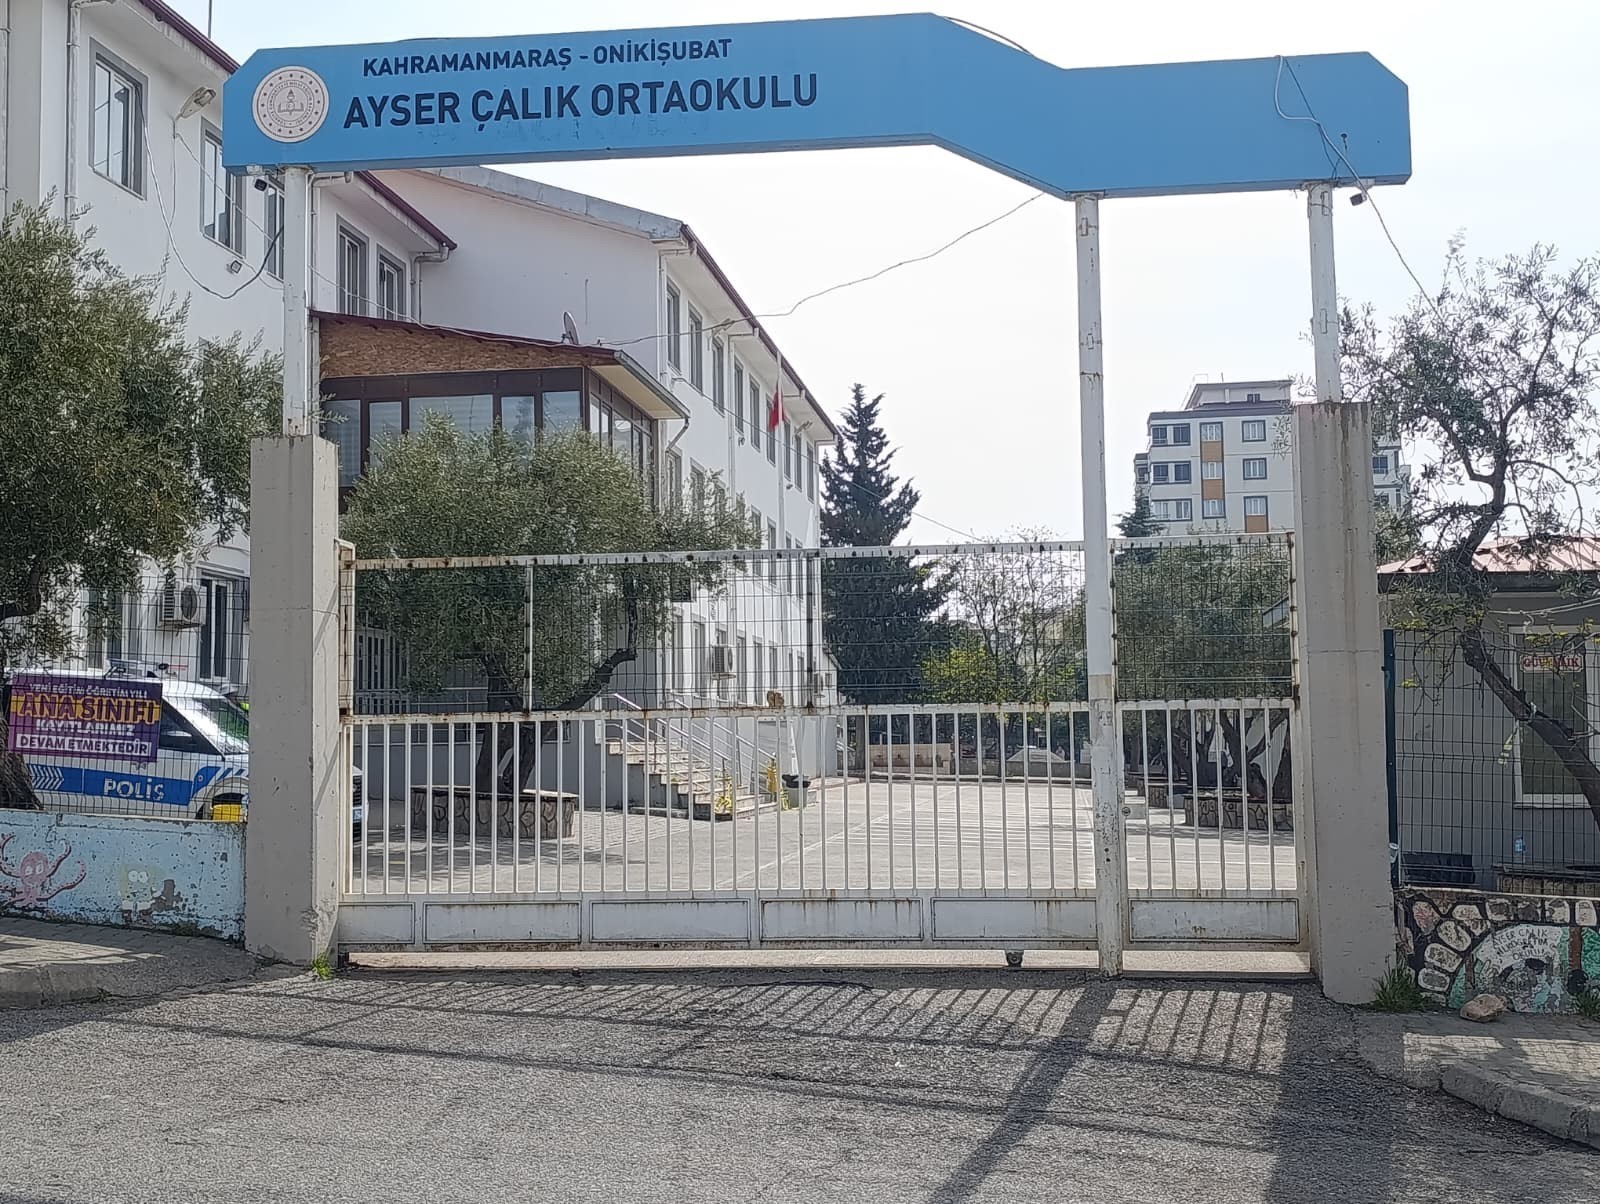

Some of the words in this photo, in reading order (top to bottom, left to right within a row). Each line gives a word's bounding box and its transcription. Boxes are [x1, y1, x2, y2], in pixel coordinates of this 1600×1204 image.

[363, 47, 572, 77] KAHRAMANMARAŞ
[593, 38, 732, 66] ONİKİŞUBAT
[343, 91, 460, 129] AYSER
[471, 85, 581, 132] ÇALIK
[591, 73, 817, 117] ORTAOKULU
[18, 692, 75, 720] ANA
[79, 695, 157, 724] SINIFI
[36, 718, 136, 736] KAYITLARIMIZ
[20, 735, 65, 751] DEVAM
[68, 738, 148, 755] ETMEKTEDİR
[103, 777, 165, 801] POLİS
